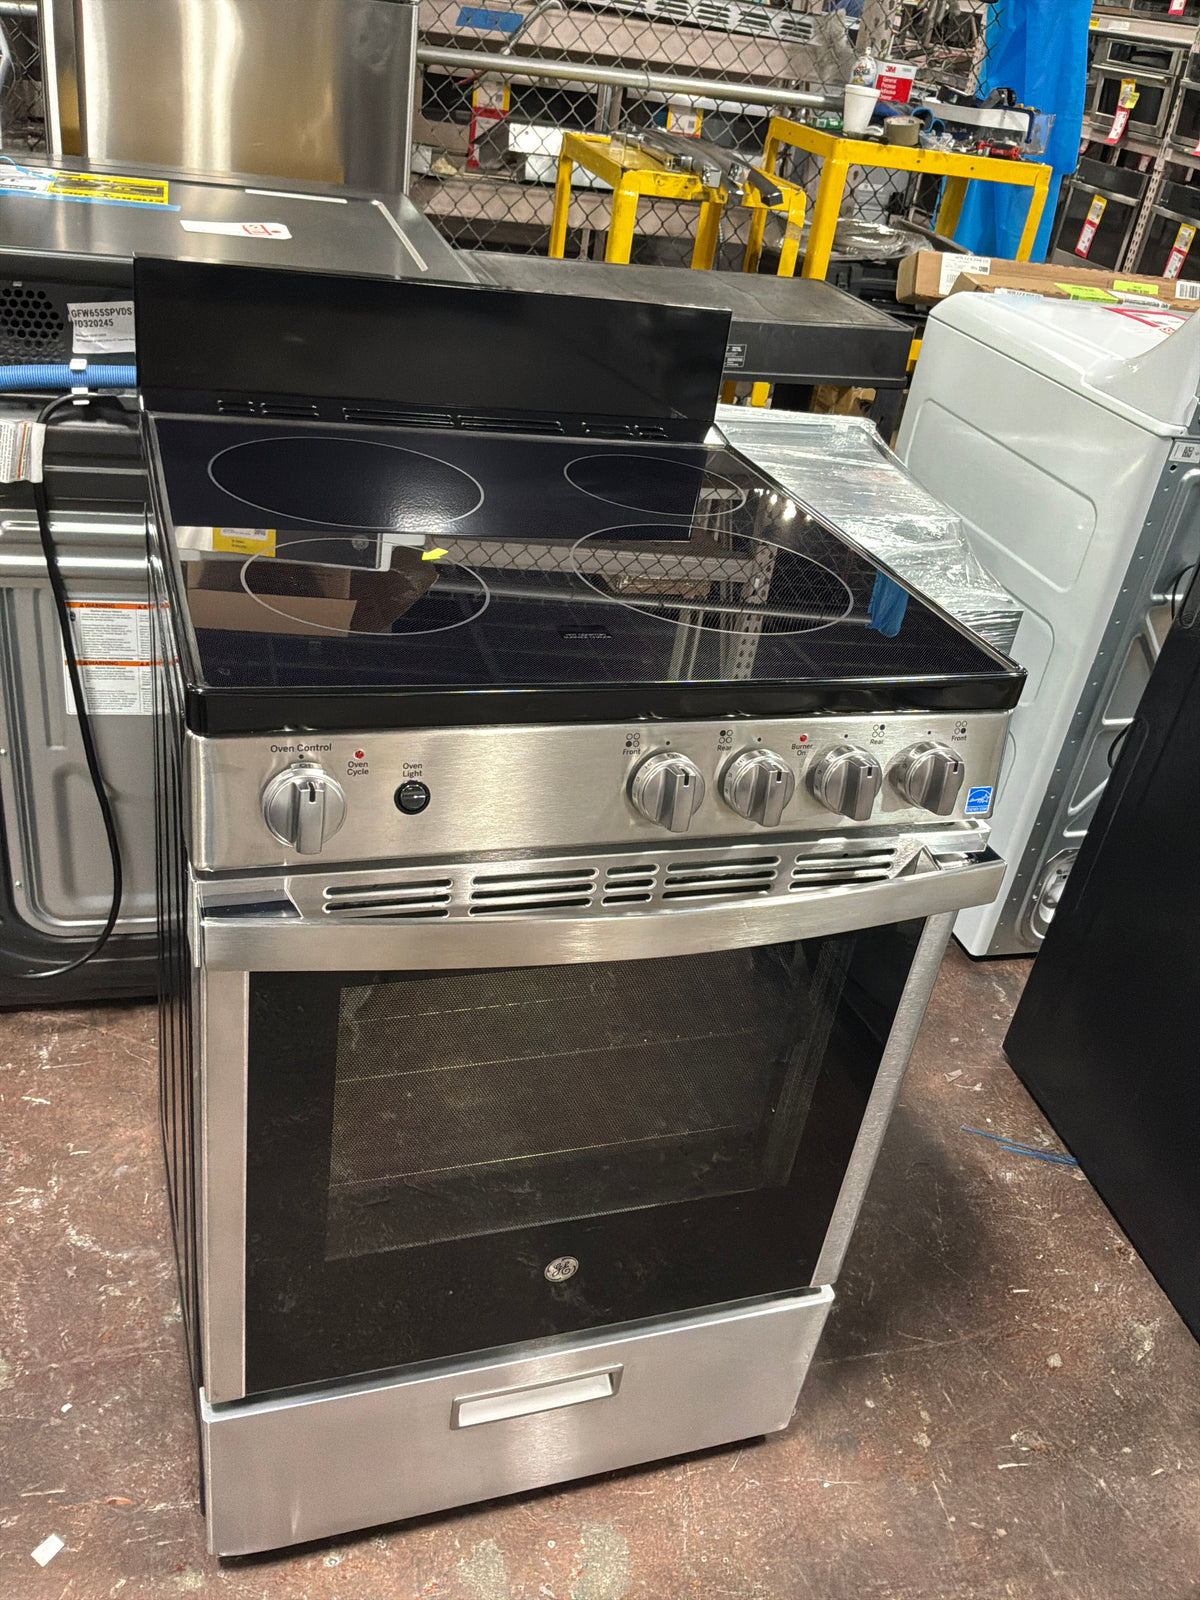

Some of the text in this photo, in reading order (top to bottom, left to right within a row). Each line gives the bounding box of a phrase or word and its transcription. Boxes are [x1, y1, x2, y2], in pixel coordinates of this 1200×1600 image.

[885, 65, 896, 73] 3M
[951, 734, 967, 742] Front
[270, 743, 332, 753] Oven Control
[347, 768, 369, 776] Cycle
[402, 770, 423, 778] Light
